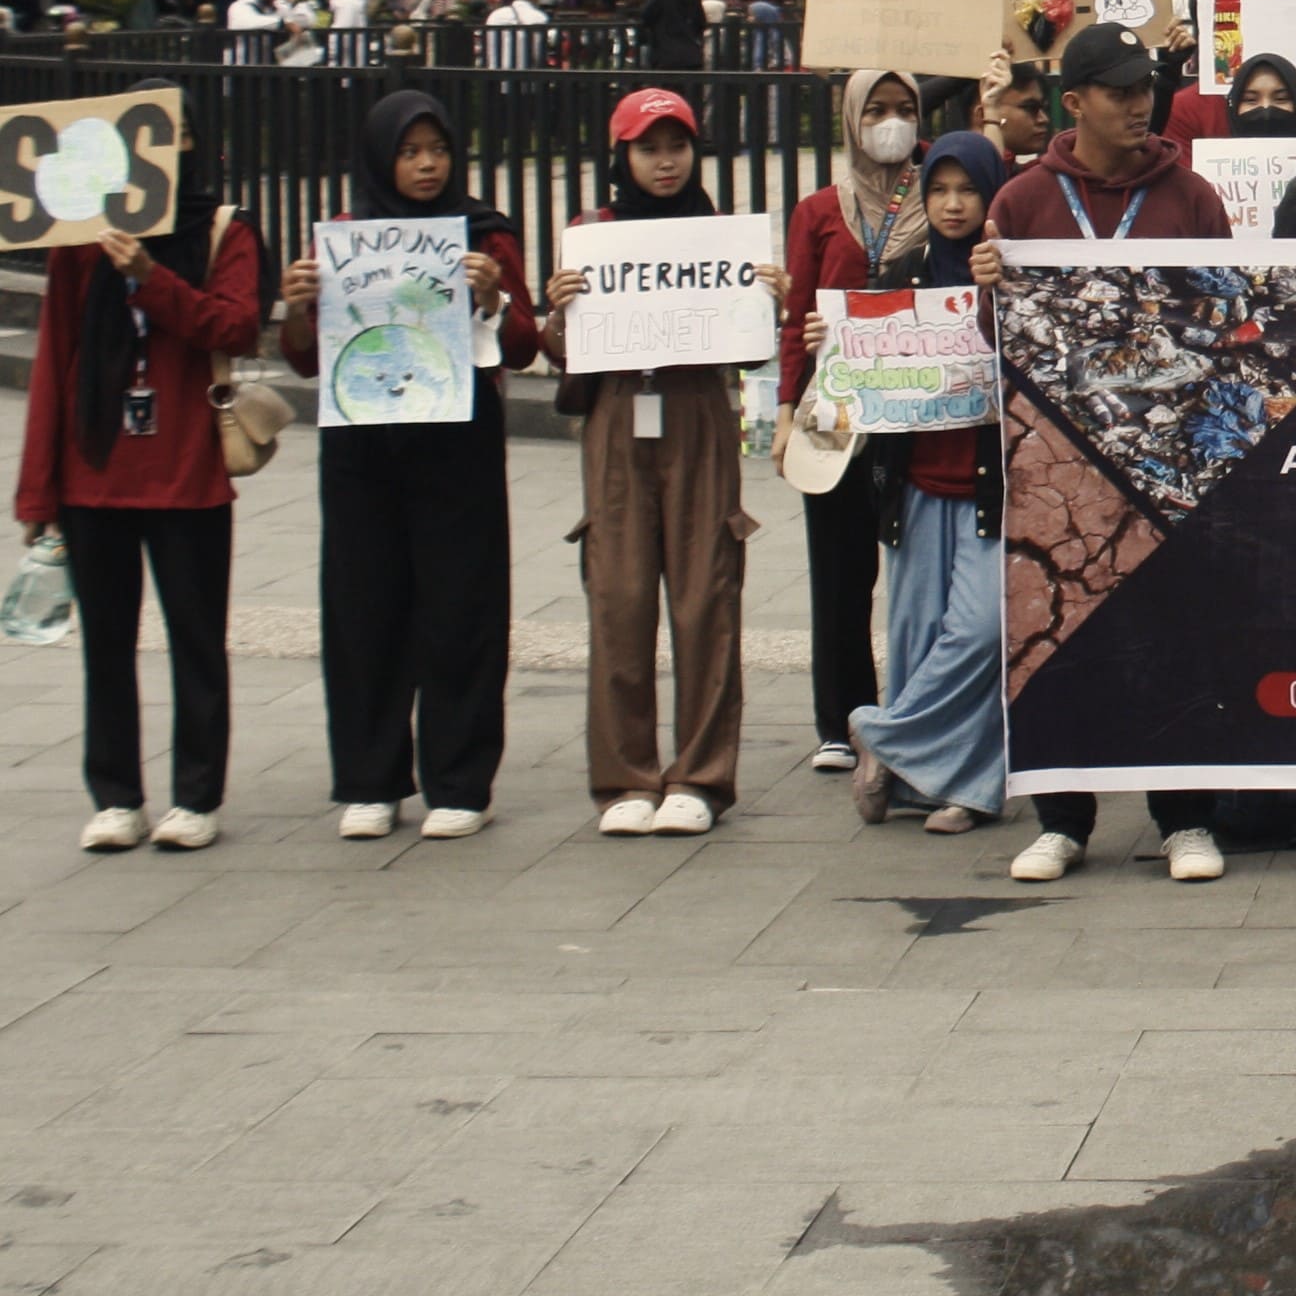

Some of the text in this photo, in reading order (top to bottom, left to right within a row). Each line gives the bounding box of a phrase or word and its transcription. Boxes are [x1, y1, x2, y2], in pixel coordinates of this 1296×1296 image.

[1205, 155, 1260, 177] THIS
[1266, 155, 1284, 176] IS
[400, 260, 457, 304] KITA
[579, 260, 757, 296] SUPERHERO
[578, 307, 720, 355] PLANET
[857, 387, 987, 426] Darurat
